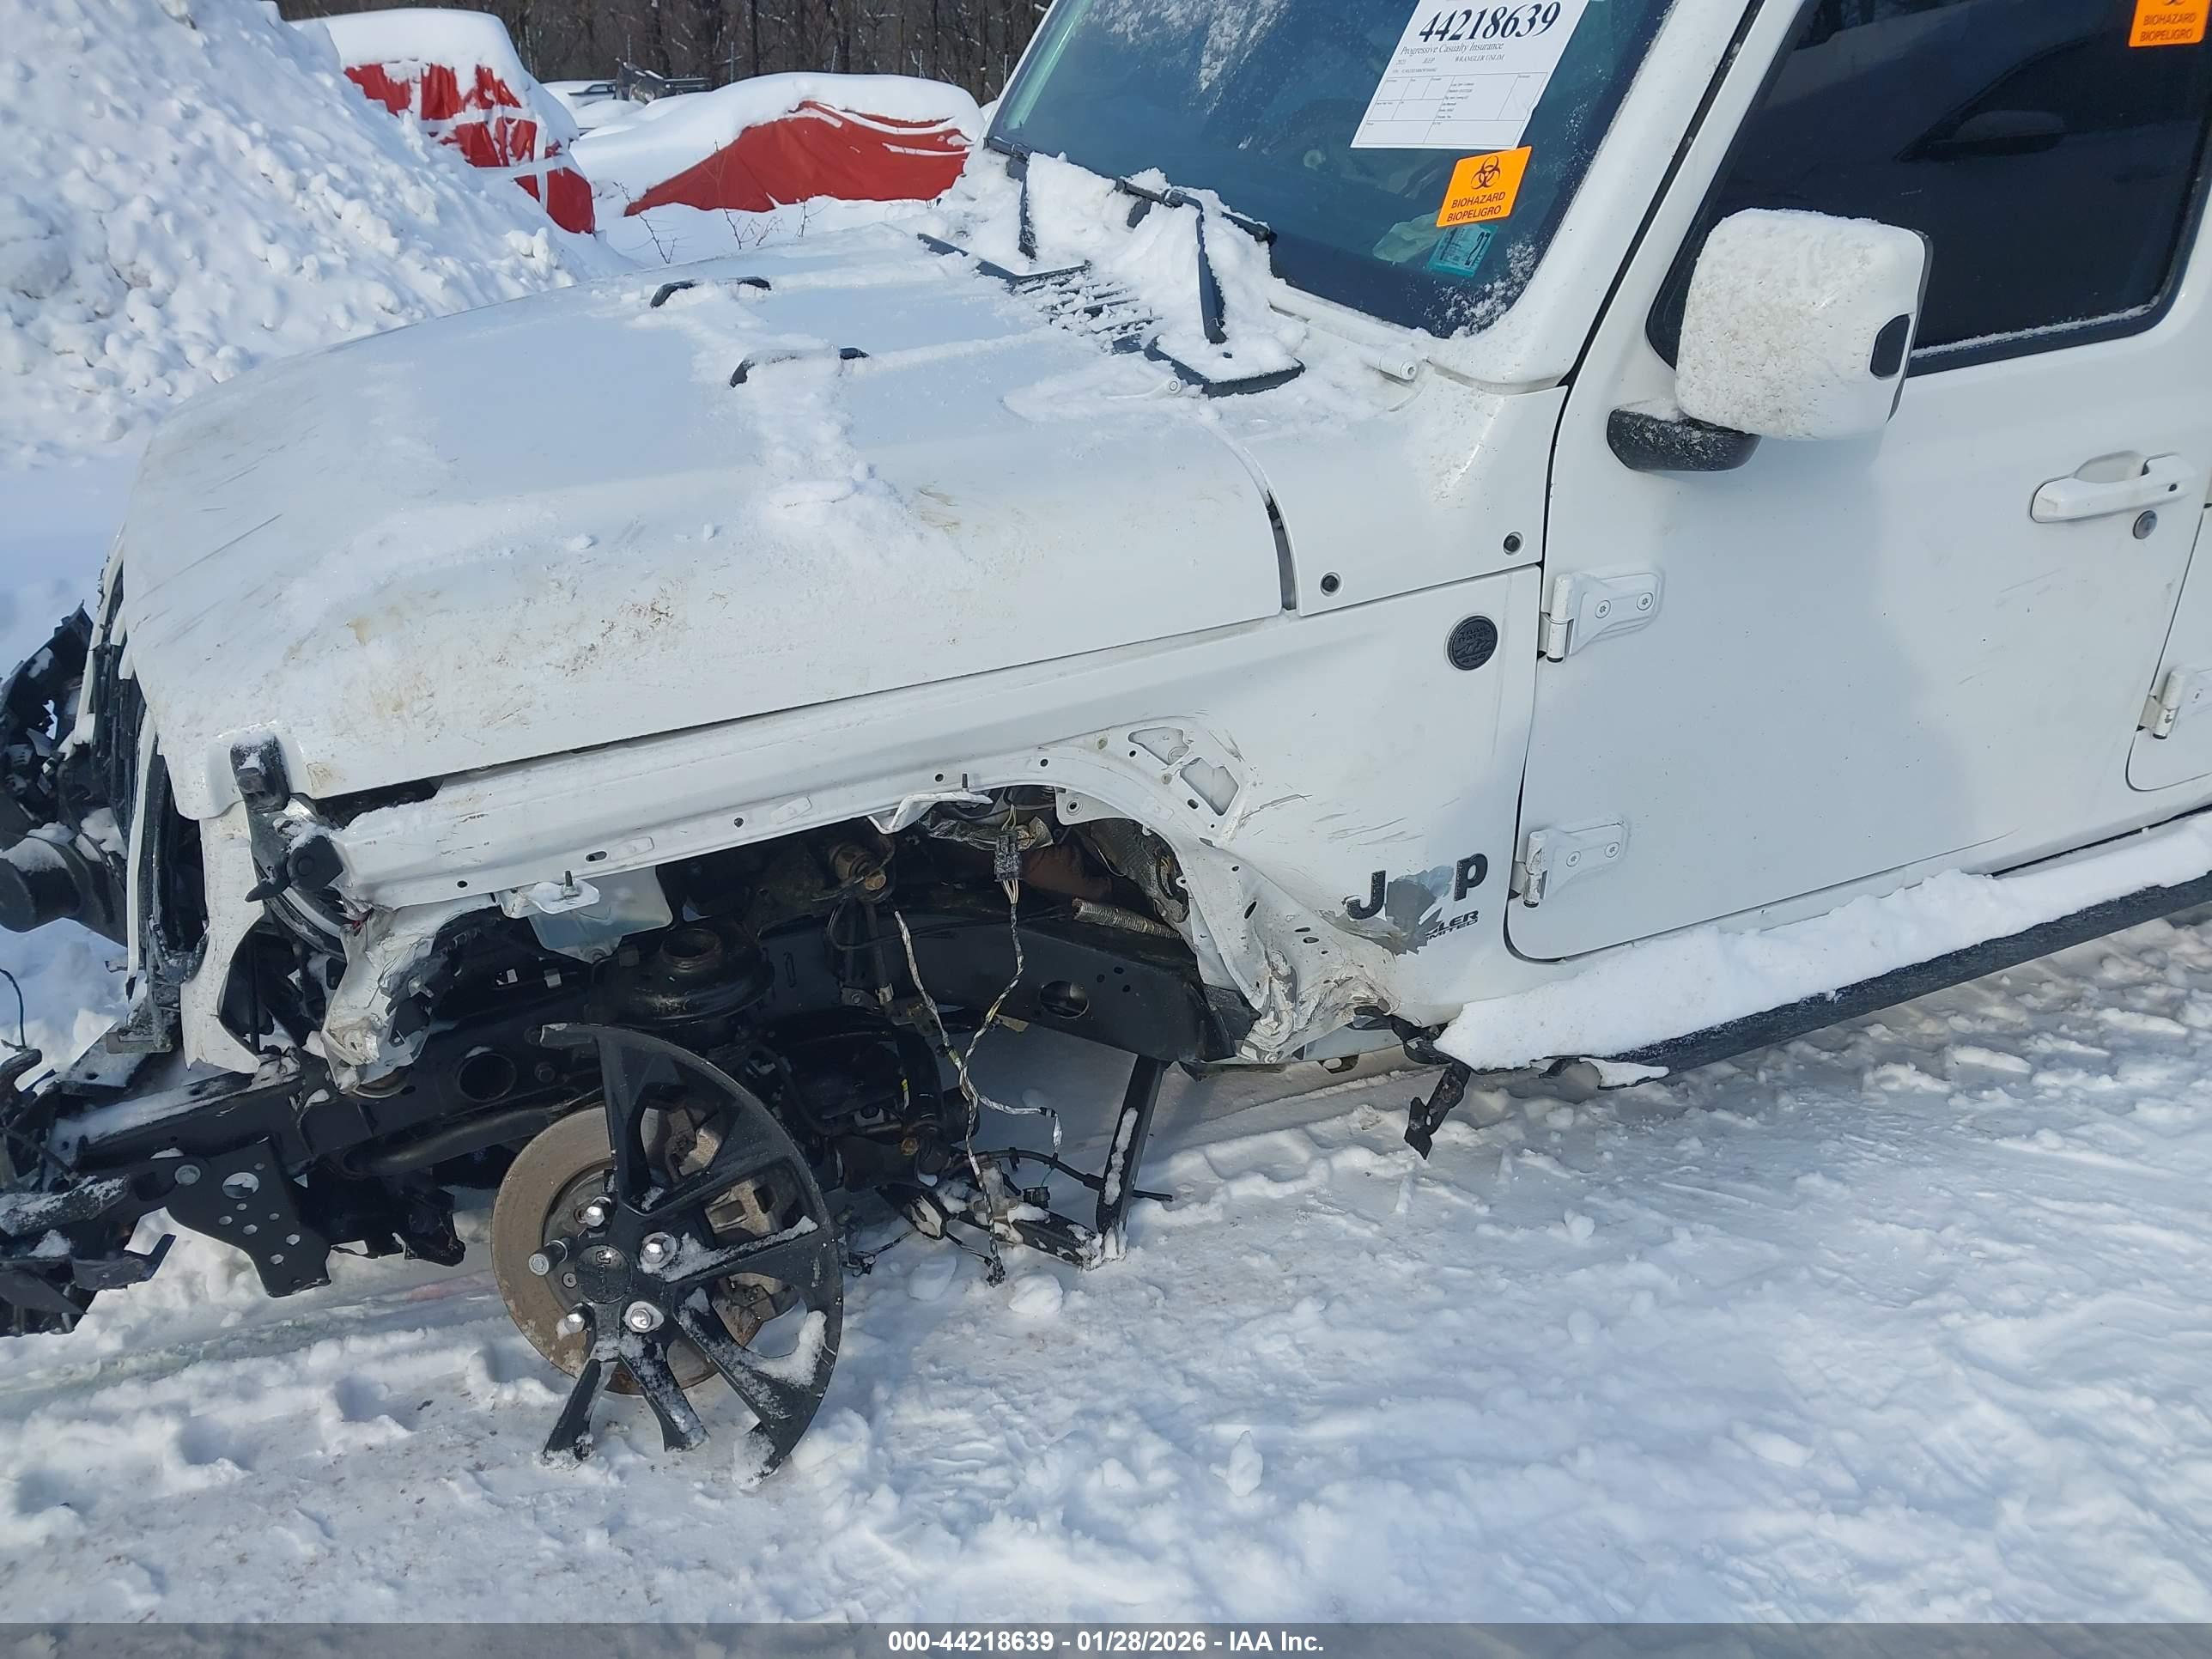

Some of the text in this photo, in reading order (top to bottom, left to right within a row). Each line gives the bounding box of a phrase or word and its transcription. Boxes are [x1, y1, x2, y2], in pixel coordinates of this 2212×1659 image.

[1419, 2, 1561, 43] 44218639
[2142, 13, 2197, 27] BIOHAZARD
[2139, 28, 2192, 42] BIOPELIGRO
[1401, 41, 1504, 57] Progressive Casualty Insurance
[1451, 191, 1505, 209] BIOHAZARD
[1446, 204, 1502, 222] BIOPELIGRO
[1341, 854, 1488, 921] JP
